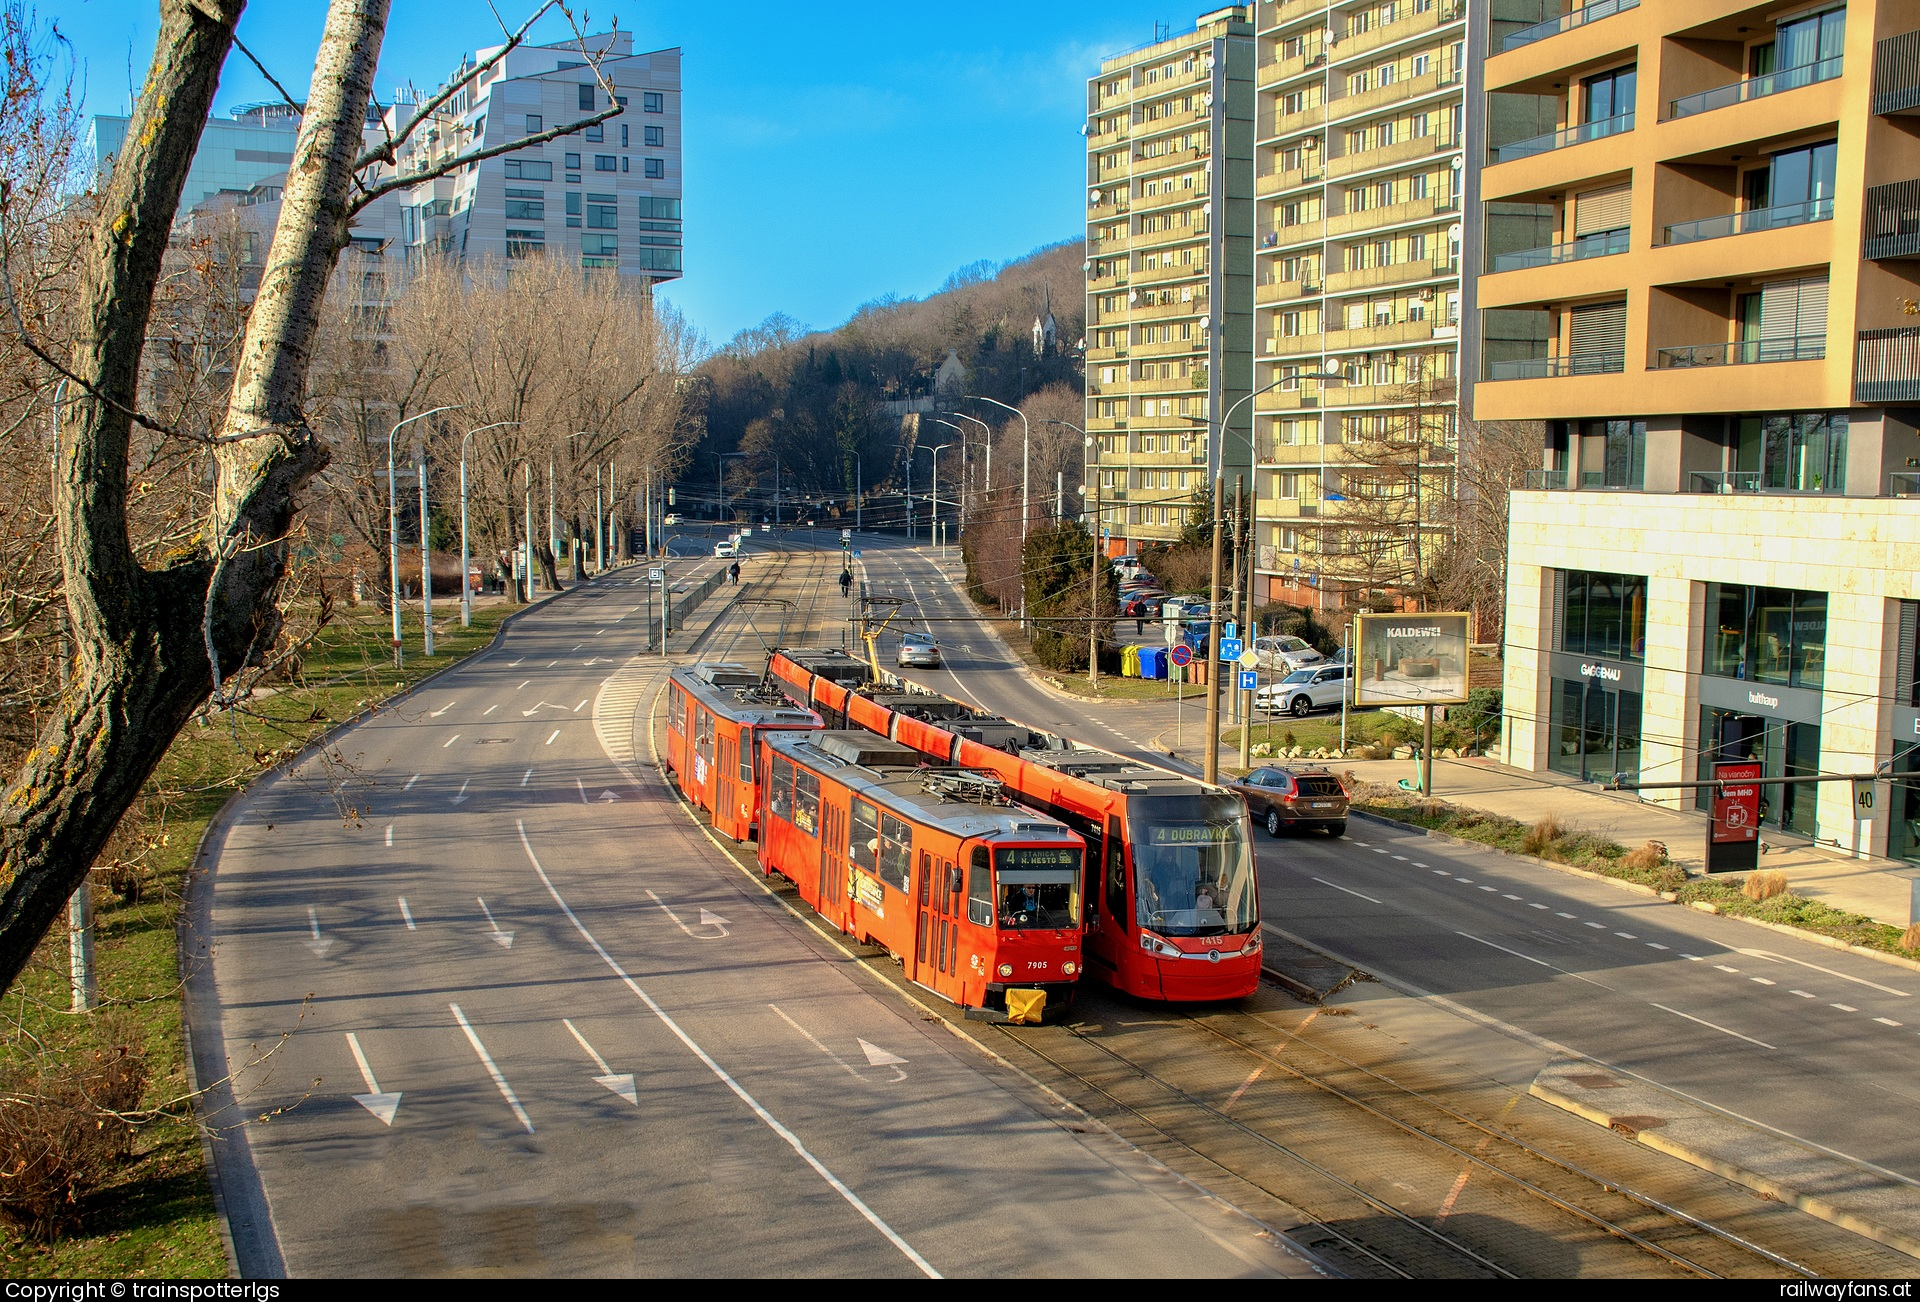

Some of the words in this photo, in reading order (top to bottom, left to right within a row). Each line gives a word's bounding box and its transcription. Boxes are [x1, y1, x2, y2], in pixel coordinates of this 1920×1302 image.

[1386, 627, 1440, 638] KALDEWEI
[1580, 663, 1621, 681] GAGGENAU
[1748, 690, 1778, 709] bulthaup
[1718, 771, 1728, 779] Na
[1722, 789, 1736, 797] dem
[1737, 789, 1753, 797] MHD
[1858, 791, 1873, 808] 40
[1157, 828, 1165, 841] 4
[1006, 849, 1015, 864] 4
[1200, 937, 1222, 945] 7415
[1027, 961, 1048, 969] 7905
